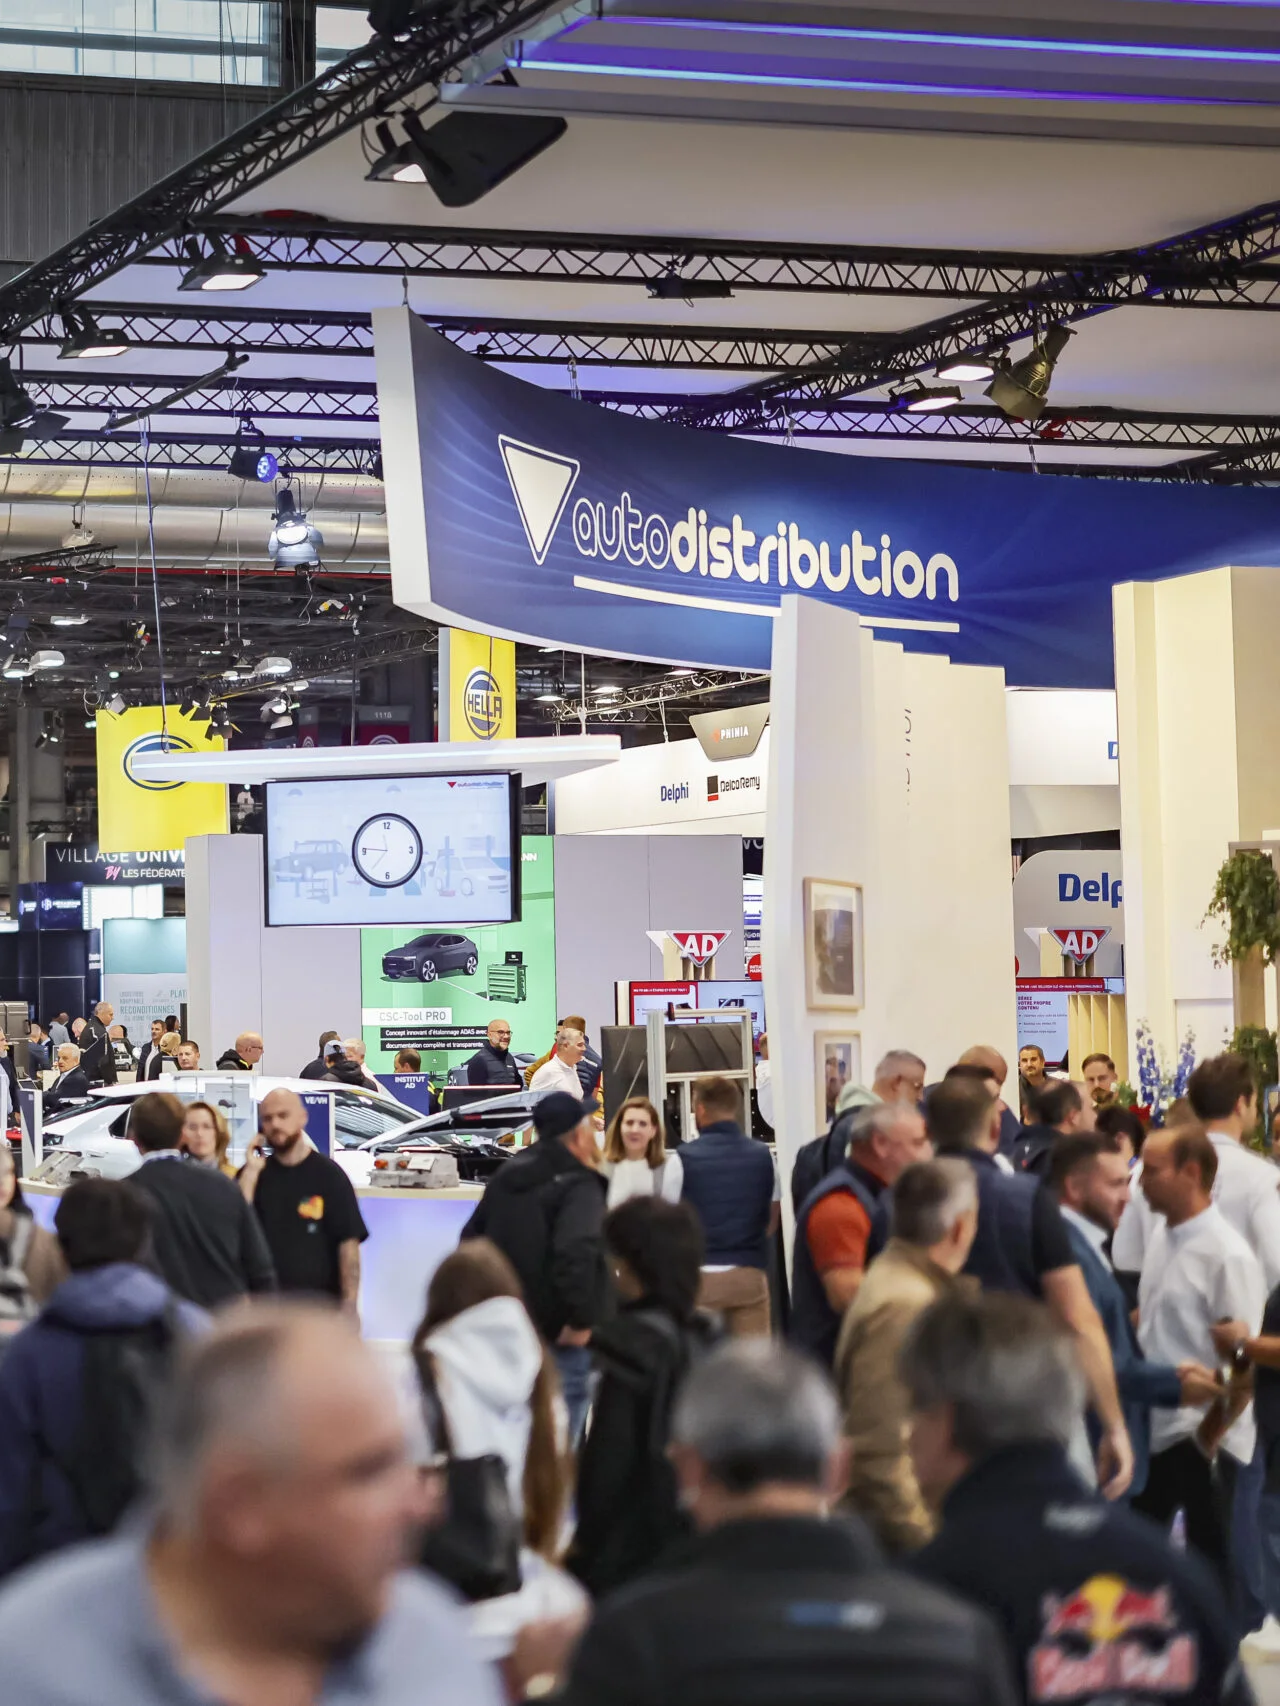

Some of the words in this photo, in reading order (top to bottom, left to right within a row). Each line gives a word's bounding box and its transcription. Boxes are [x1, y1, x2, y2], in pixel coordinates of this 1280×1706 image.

[572, 491, 959, 602] autodistribution
[466, 694, 503, 719] HELLA
[720, 726, 749, 740] PHINIA
[660, 781, 689, 802] Delphi
[383, 822, 391, 830] 12
[55, 848, 129, 863] VILLAGE
[135, 850, 185, 863] UNIV
[361, 847, 367, 855] 9
[408, 846, 414, 854] 3
[105, 865, 122, 881] BY
[122, 869, 139, 878] LES
[140, 867, 185, 878] FÉDÉRATE
[385, 872, 391, 880] 6
[1058, 872, 1123, 908] Delp
[681, 934, 719, 957] AD
[1062, 930, 1099, 955] AD
[379, 1011, 422, 1021] CSC-Tool
[425, 1011, 446, 1021] PRO
[385, 1029, 406, 1037] Concept
[428, 1028, 460, 1037] d'étalonnage
[423, 1041, 446, 1049] complète
